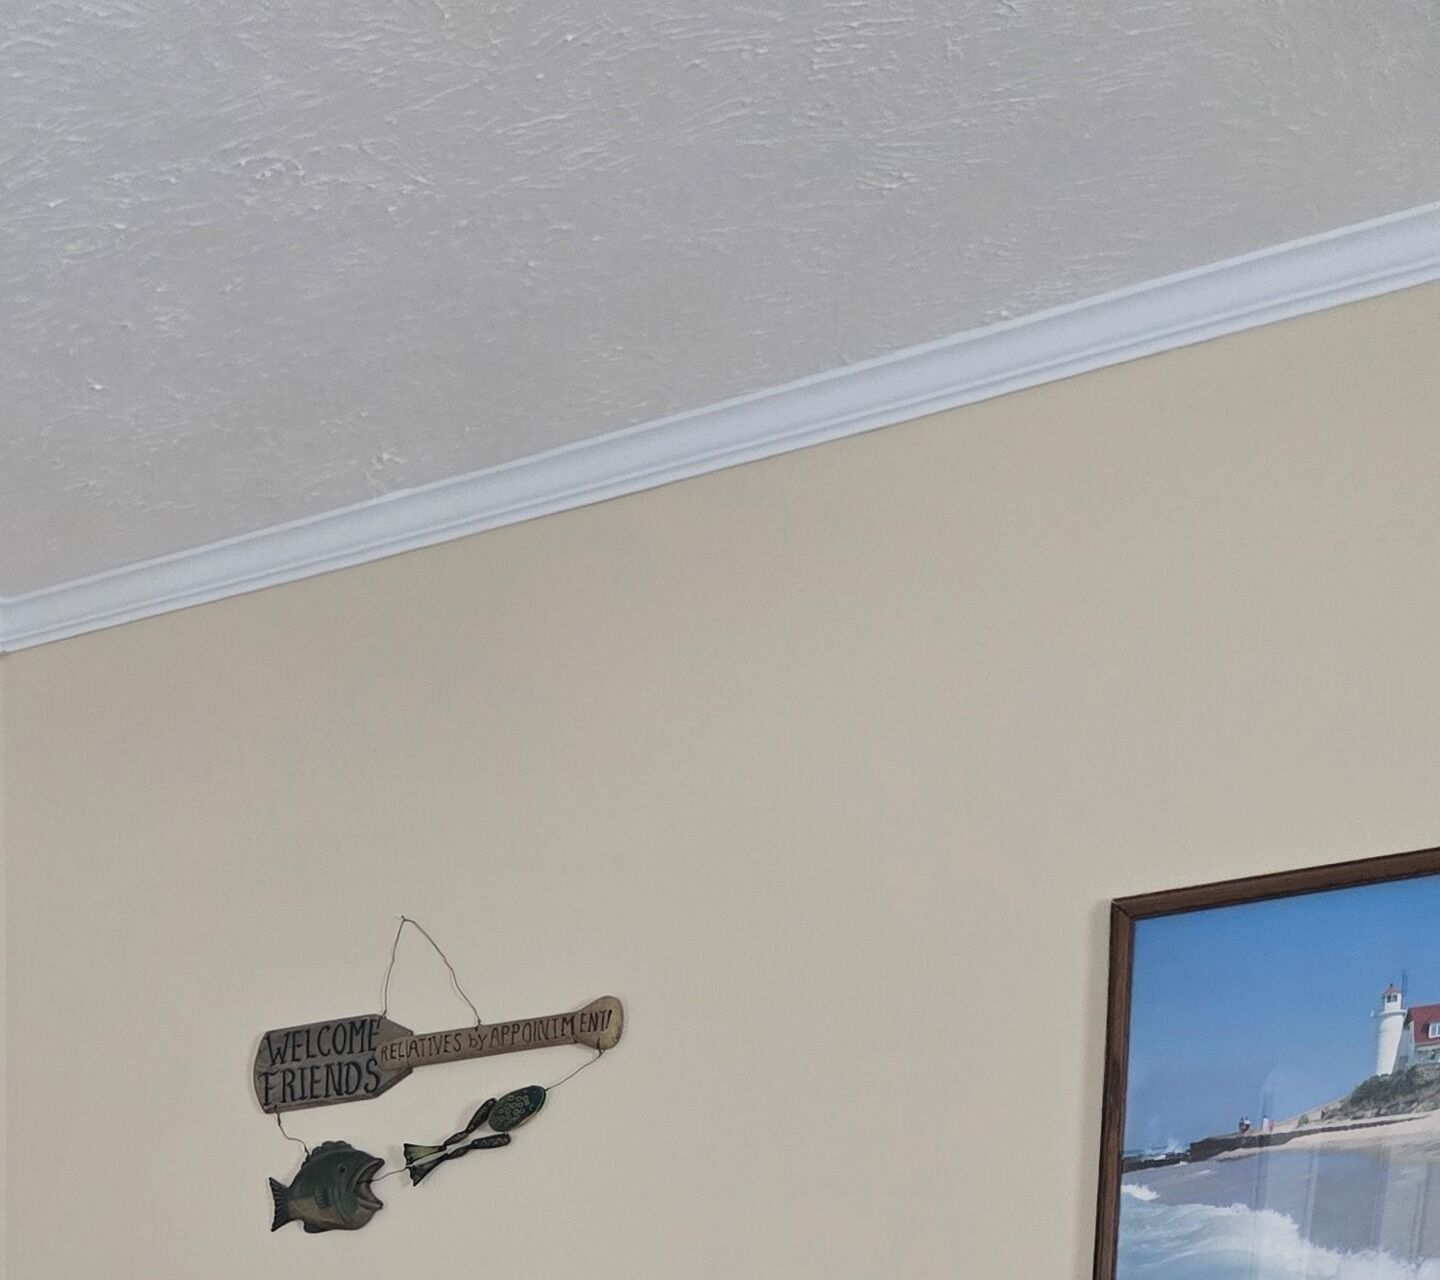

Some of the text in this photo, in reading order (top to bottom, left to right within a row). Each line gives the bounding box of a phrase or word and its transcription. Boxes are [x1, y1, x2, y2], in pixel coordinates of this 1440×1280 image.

[264, 1015, 383, 1067] WELCOME
[380, 1008, 614, 1062] RELATIVES by APPOINTMENT!
[259, 1059, 383, 1108] FRIENDS
